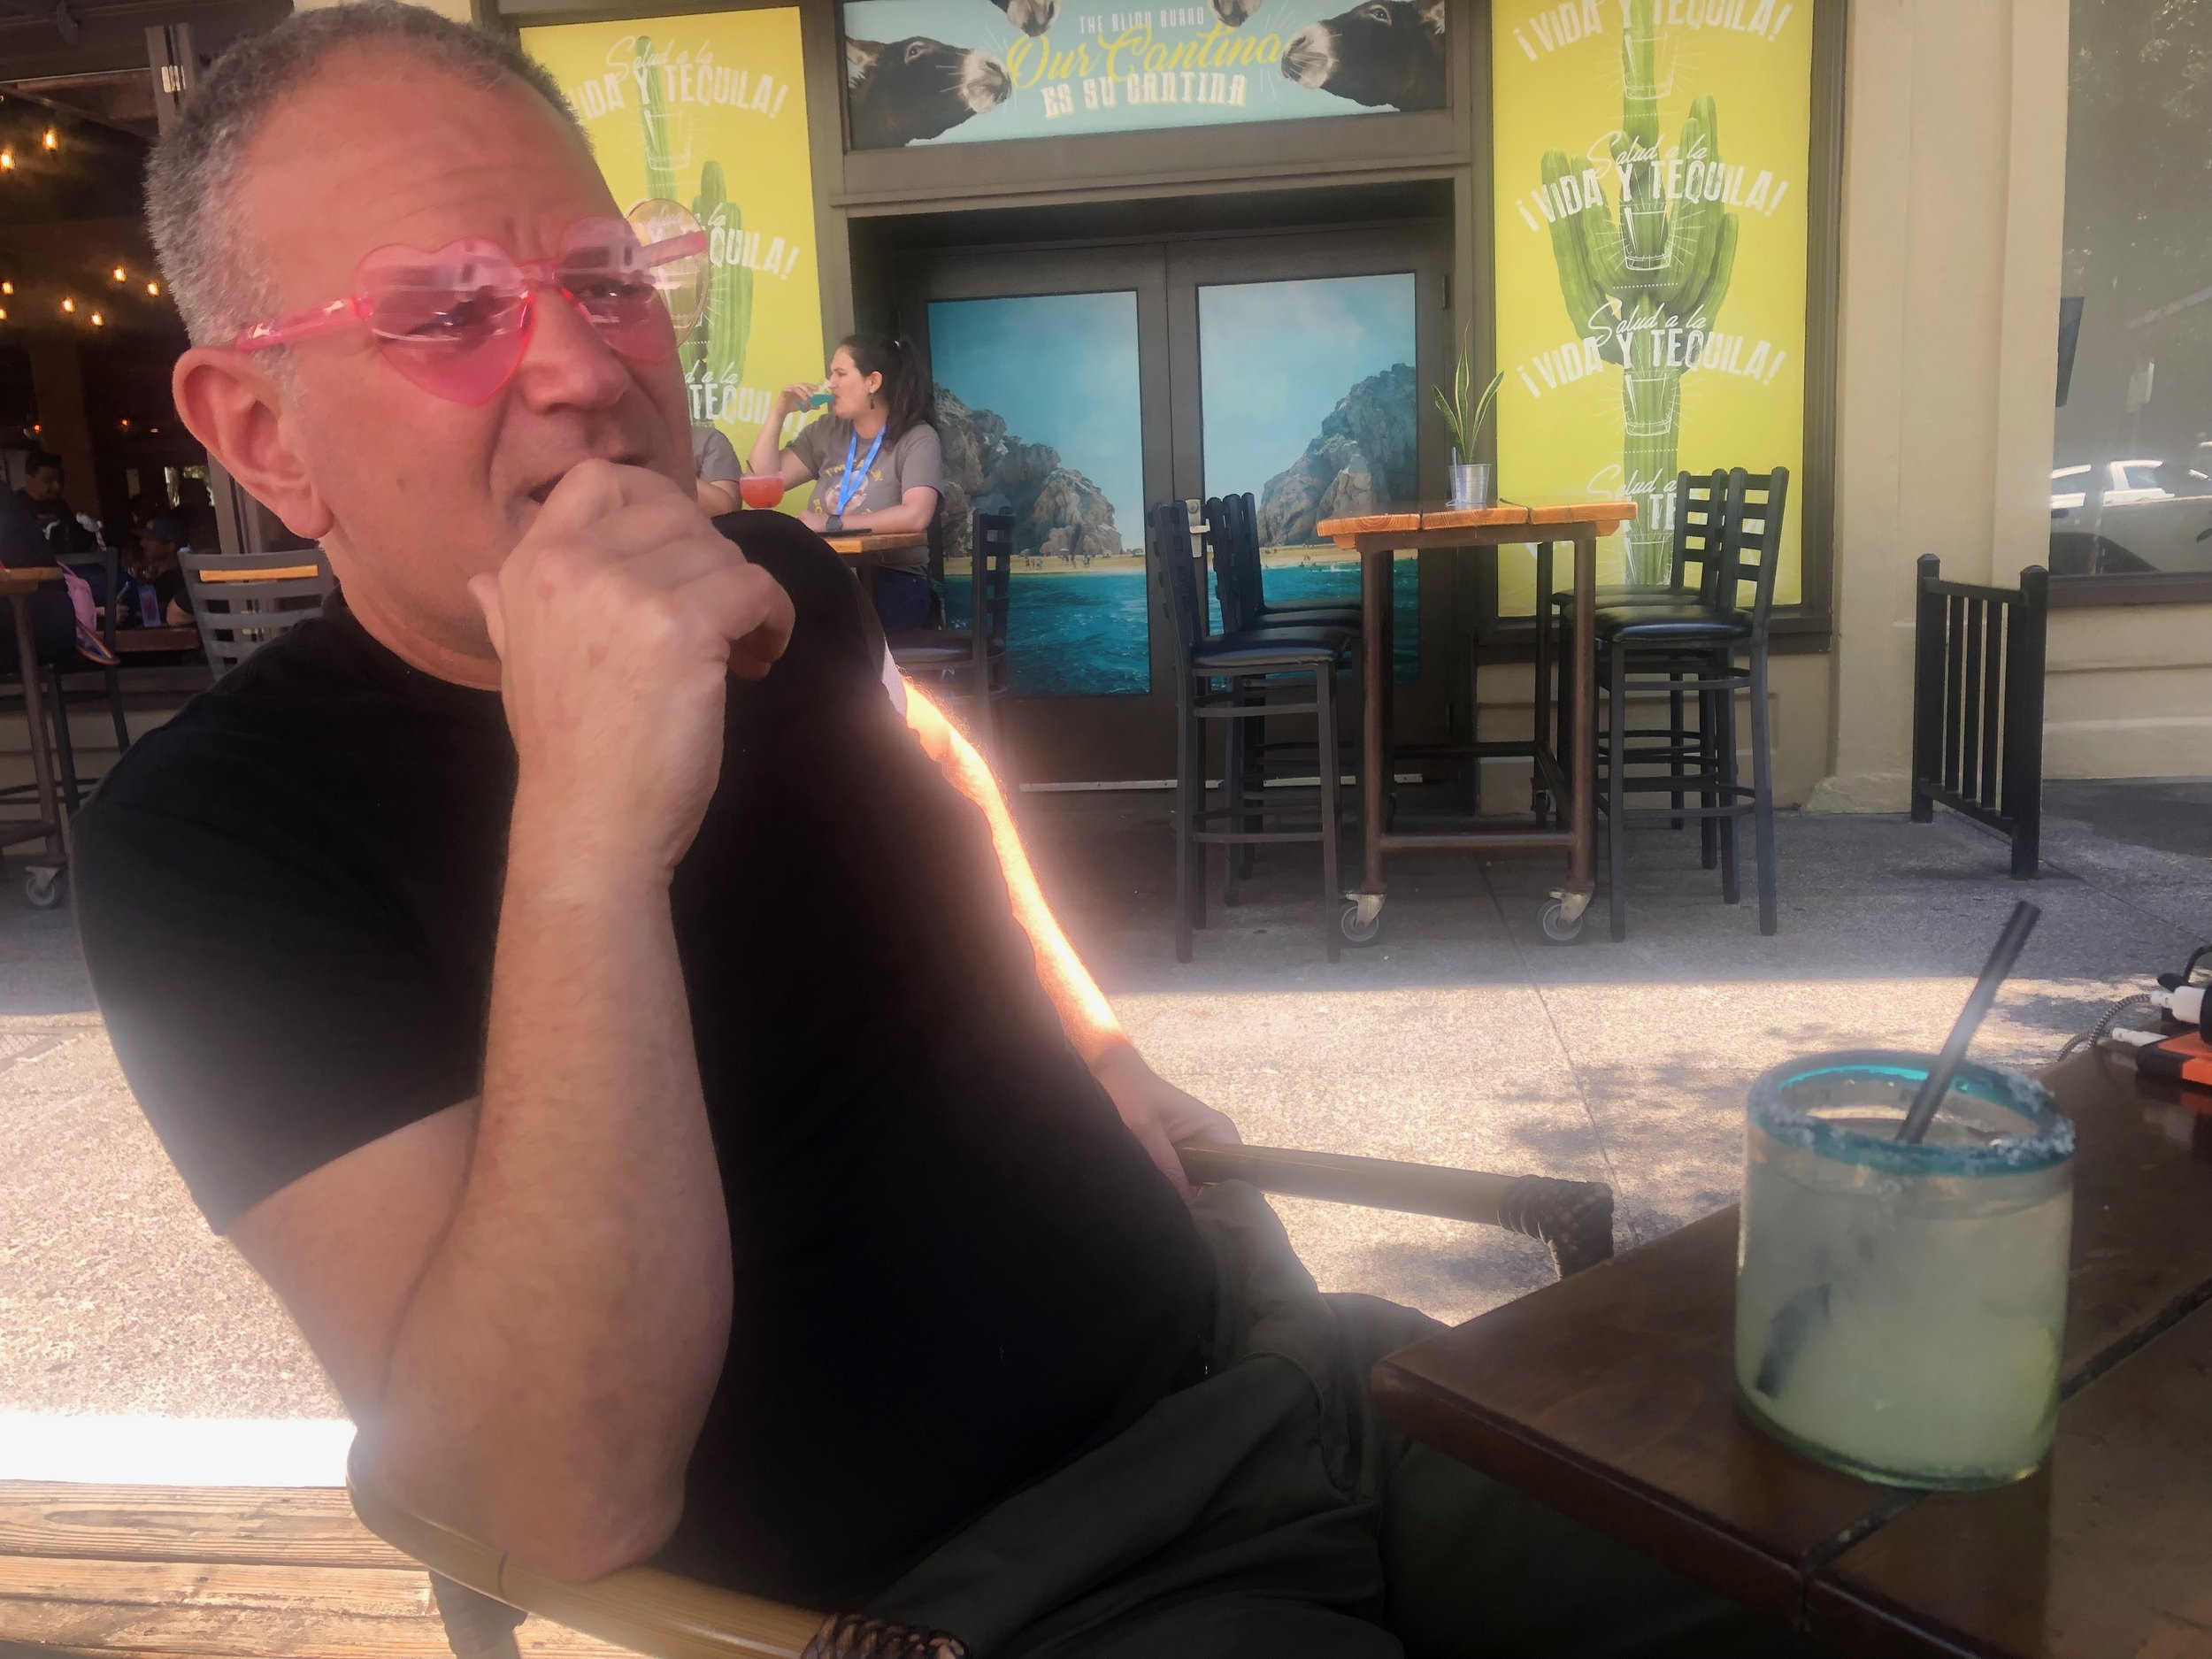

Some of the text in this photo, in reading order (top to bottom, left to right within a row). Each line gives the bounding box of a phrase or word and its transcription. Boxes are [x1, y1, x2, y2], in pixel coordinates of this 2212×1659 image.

[1079, 6, 1204, 35] THE BLIND BURRO
[1619, 0, 1633, 28] Y
[1652, 0, 1793, 42] TEQUILA!
[606, 35, 713, 82] Salud a la
[1007, 19, 1283, 89] Our Cantina
[567, 64, 789, 121] IDA Y TEQUILA!
[1040, 71, 1248, 119] ES SU CANTINA
[1586, 130, 1708, 180] Salud a la
[707, 202, 727, 227] la
[1514, 158, 1789, 233] ¡VIDA Y TEQUILA!
[709, 226, 800, 280] QUILA!
[1586, 298, 1708, 347] Salud a la
[701, 371, 714, 384] a
[719, 360, 739, 385] la
[1517, 327, 1786, 399] ¡VIDA Y TEQUILA!
[1587, 464, 1664, 502] Salud
[1663, 479, 1678, 492] a
